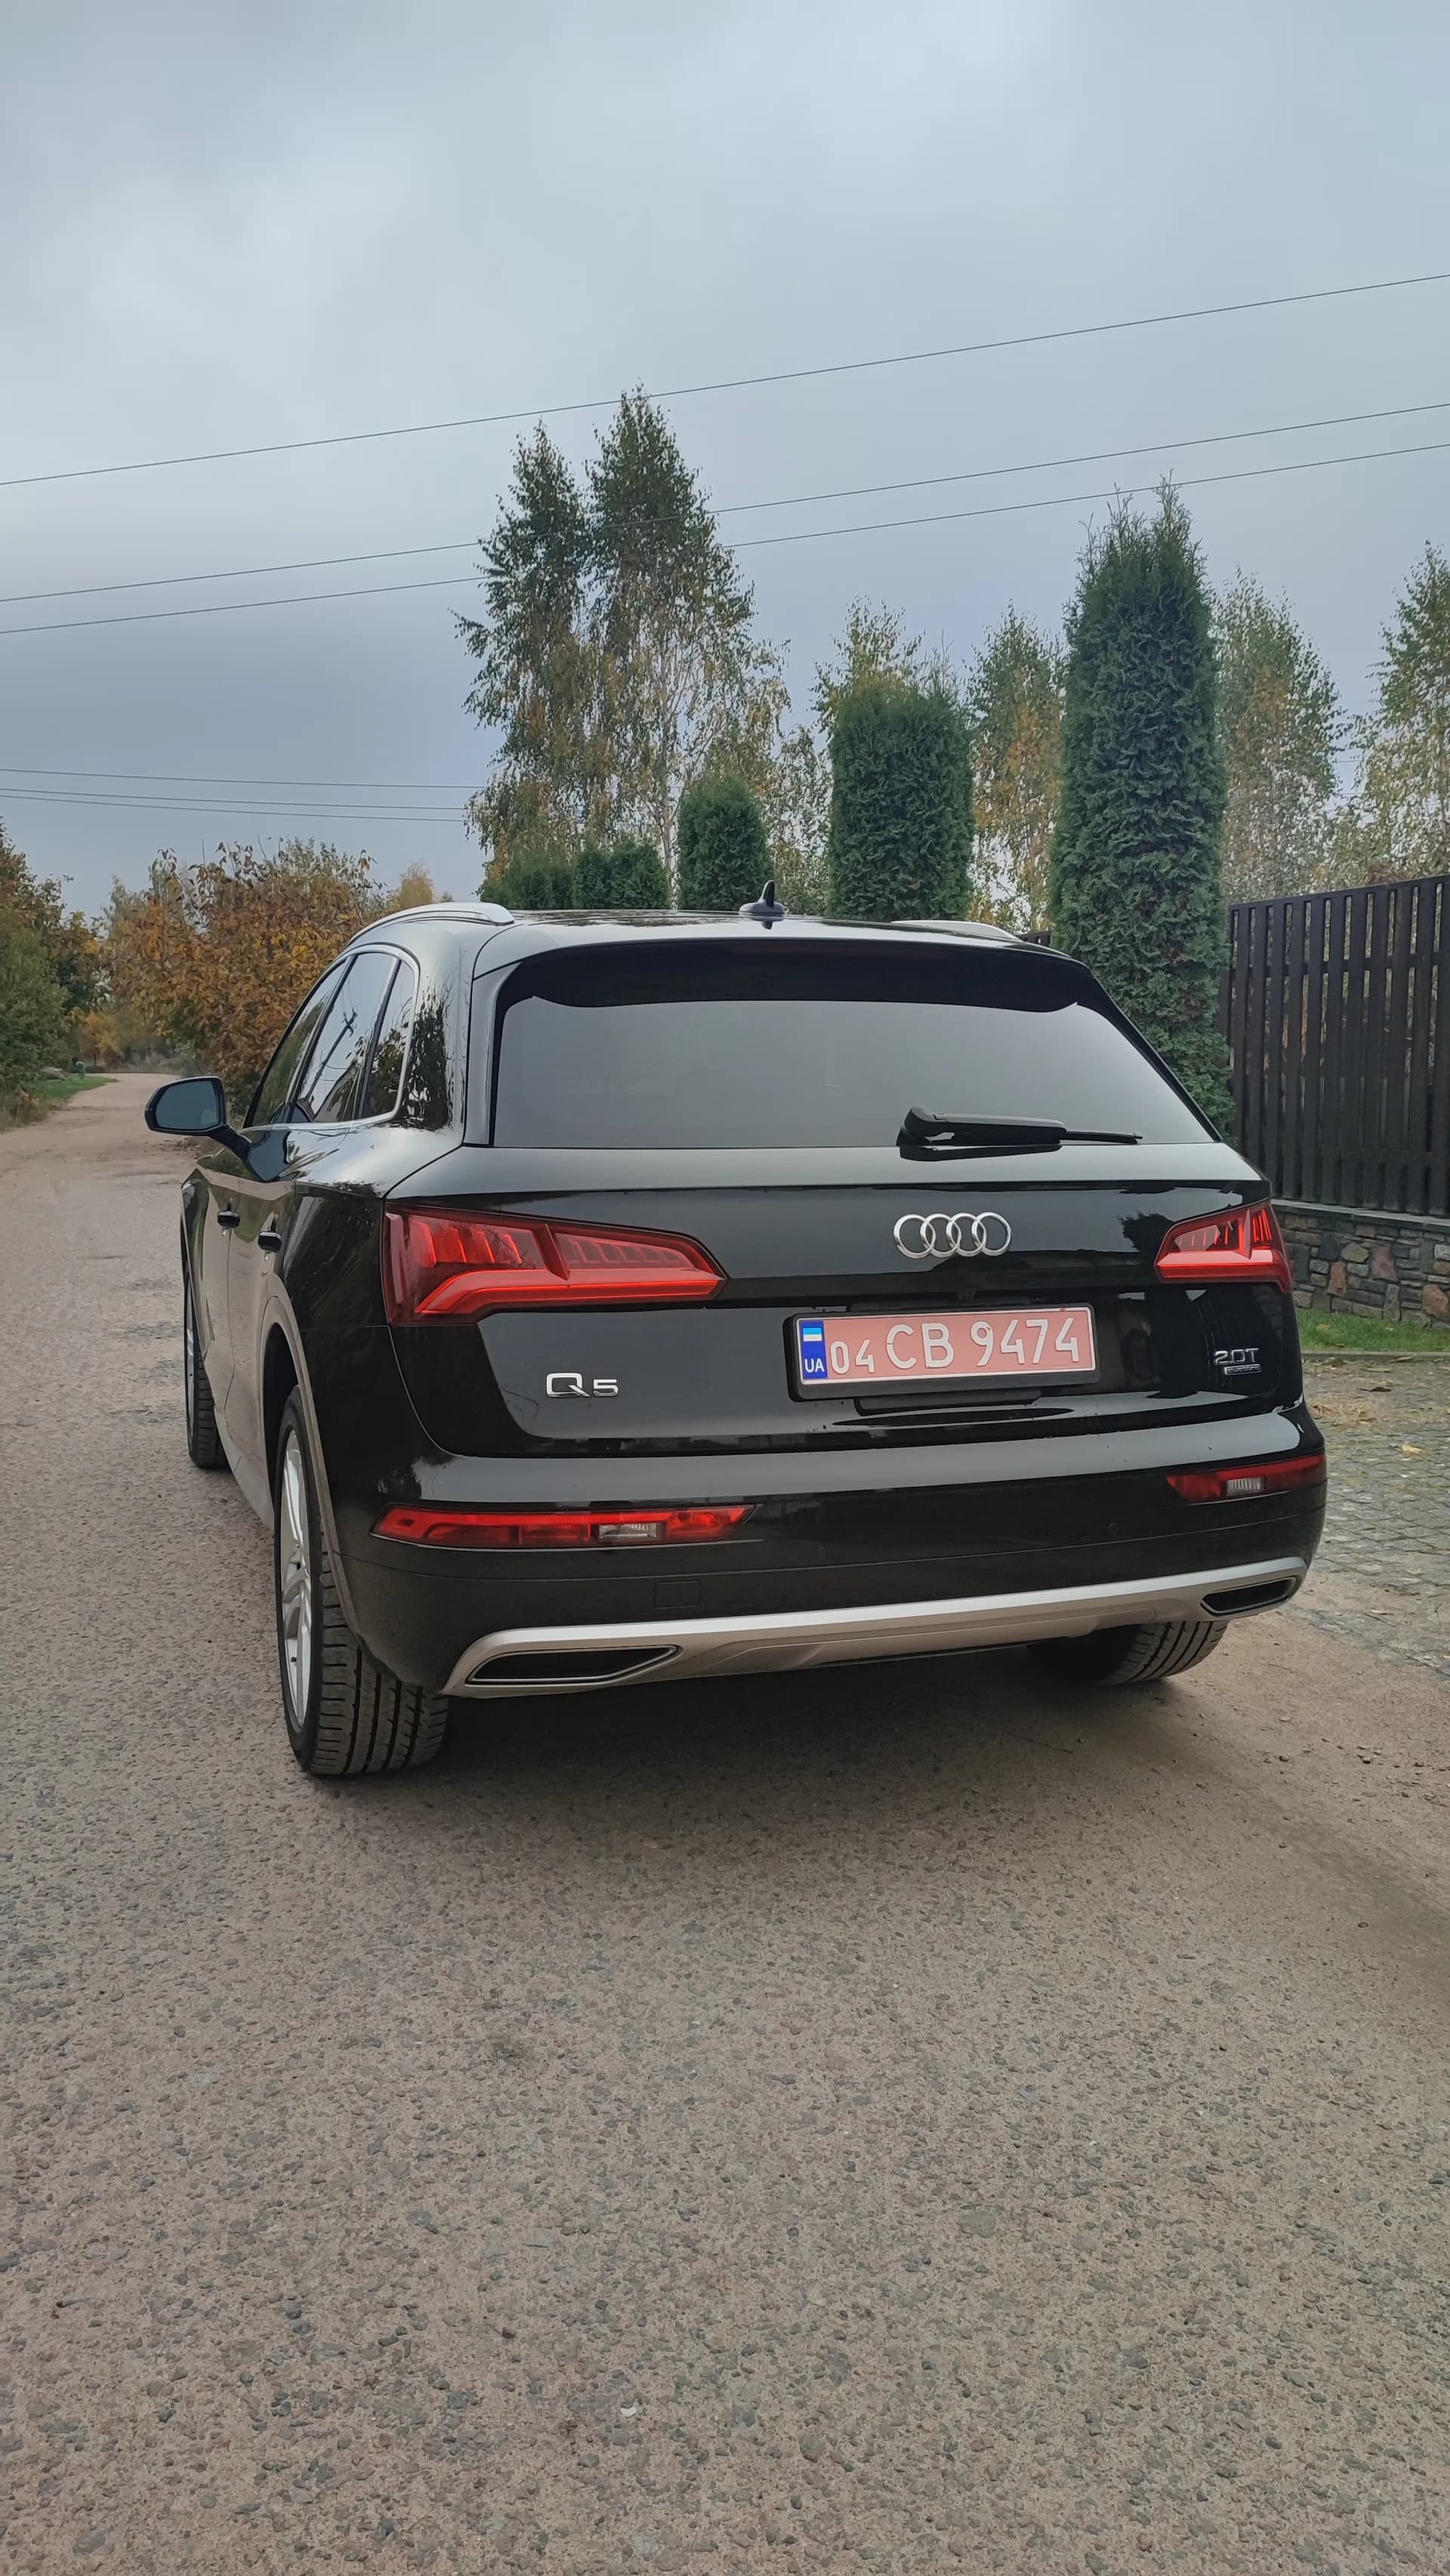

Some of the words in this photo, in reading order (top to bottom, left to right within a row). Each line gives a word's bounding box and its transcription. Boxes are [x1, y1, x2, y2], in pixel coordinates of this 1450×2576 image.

[830, 1339, 875, 1374] 04
[886, 1323, 955, 1369] CB
[970, 1317, 1079, 1367] 9474
[804, 1358, 825, 1373] UA
[546, 1372, 619, 1398] Q5
